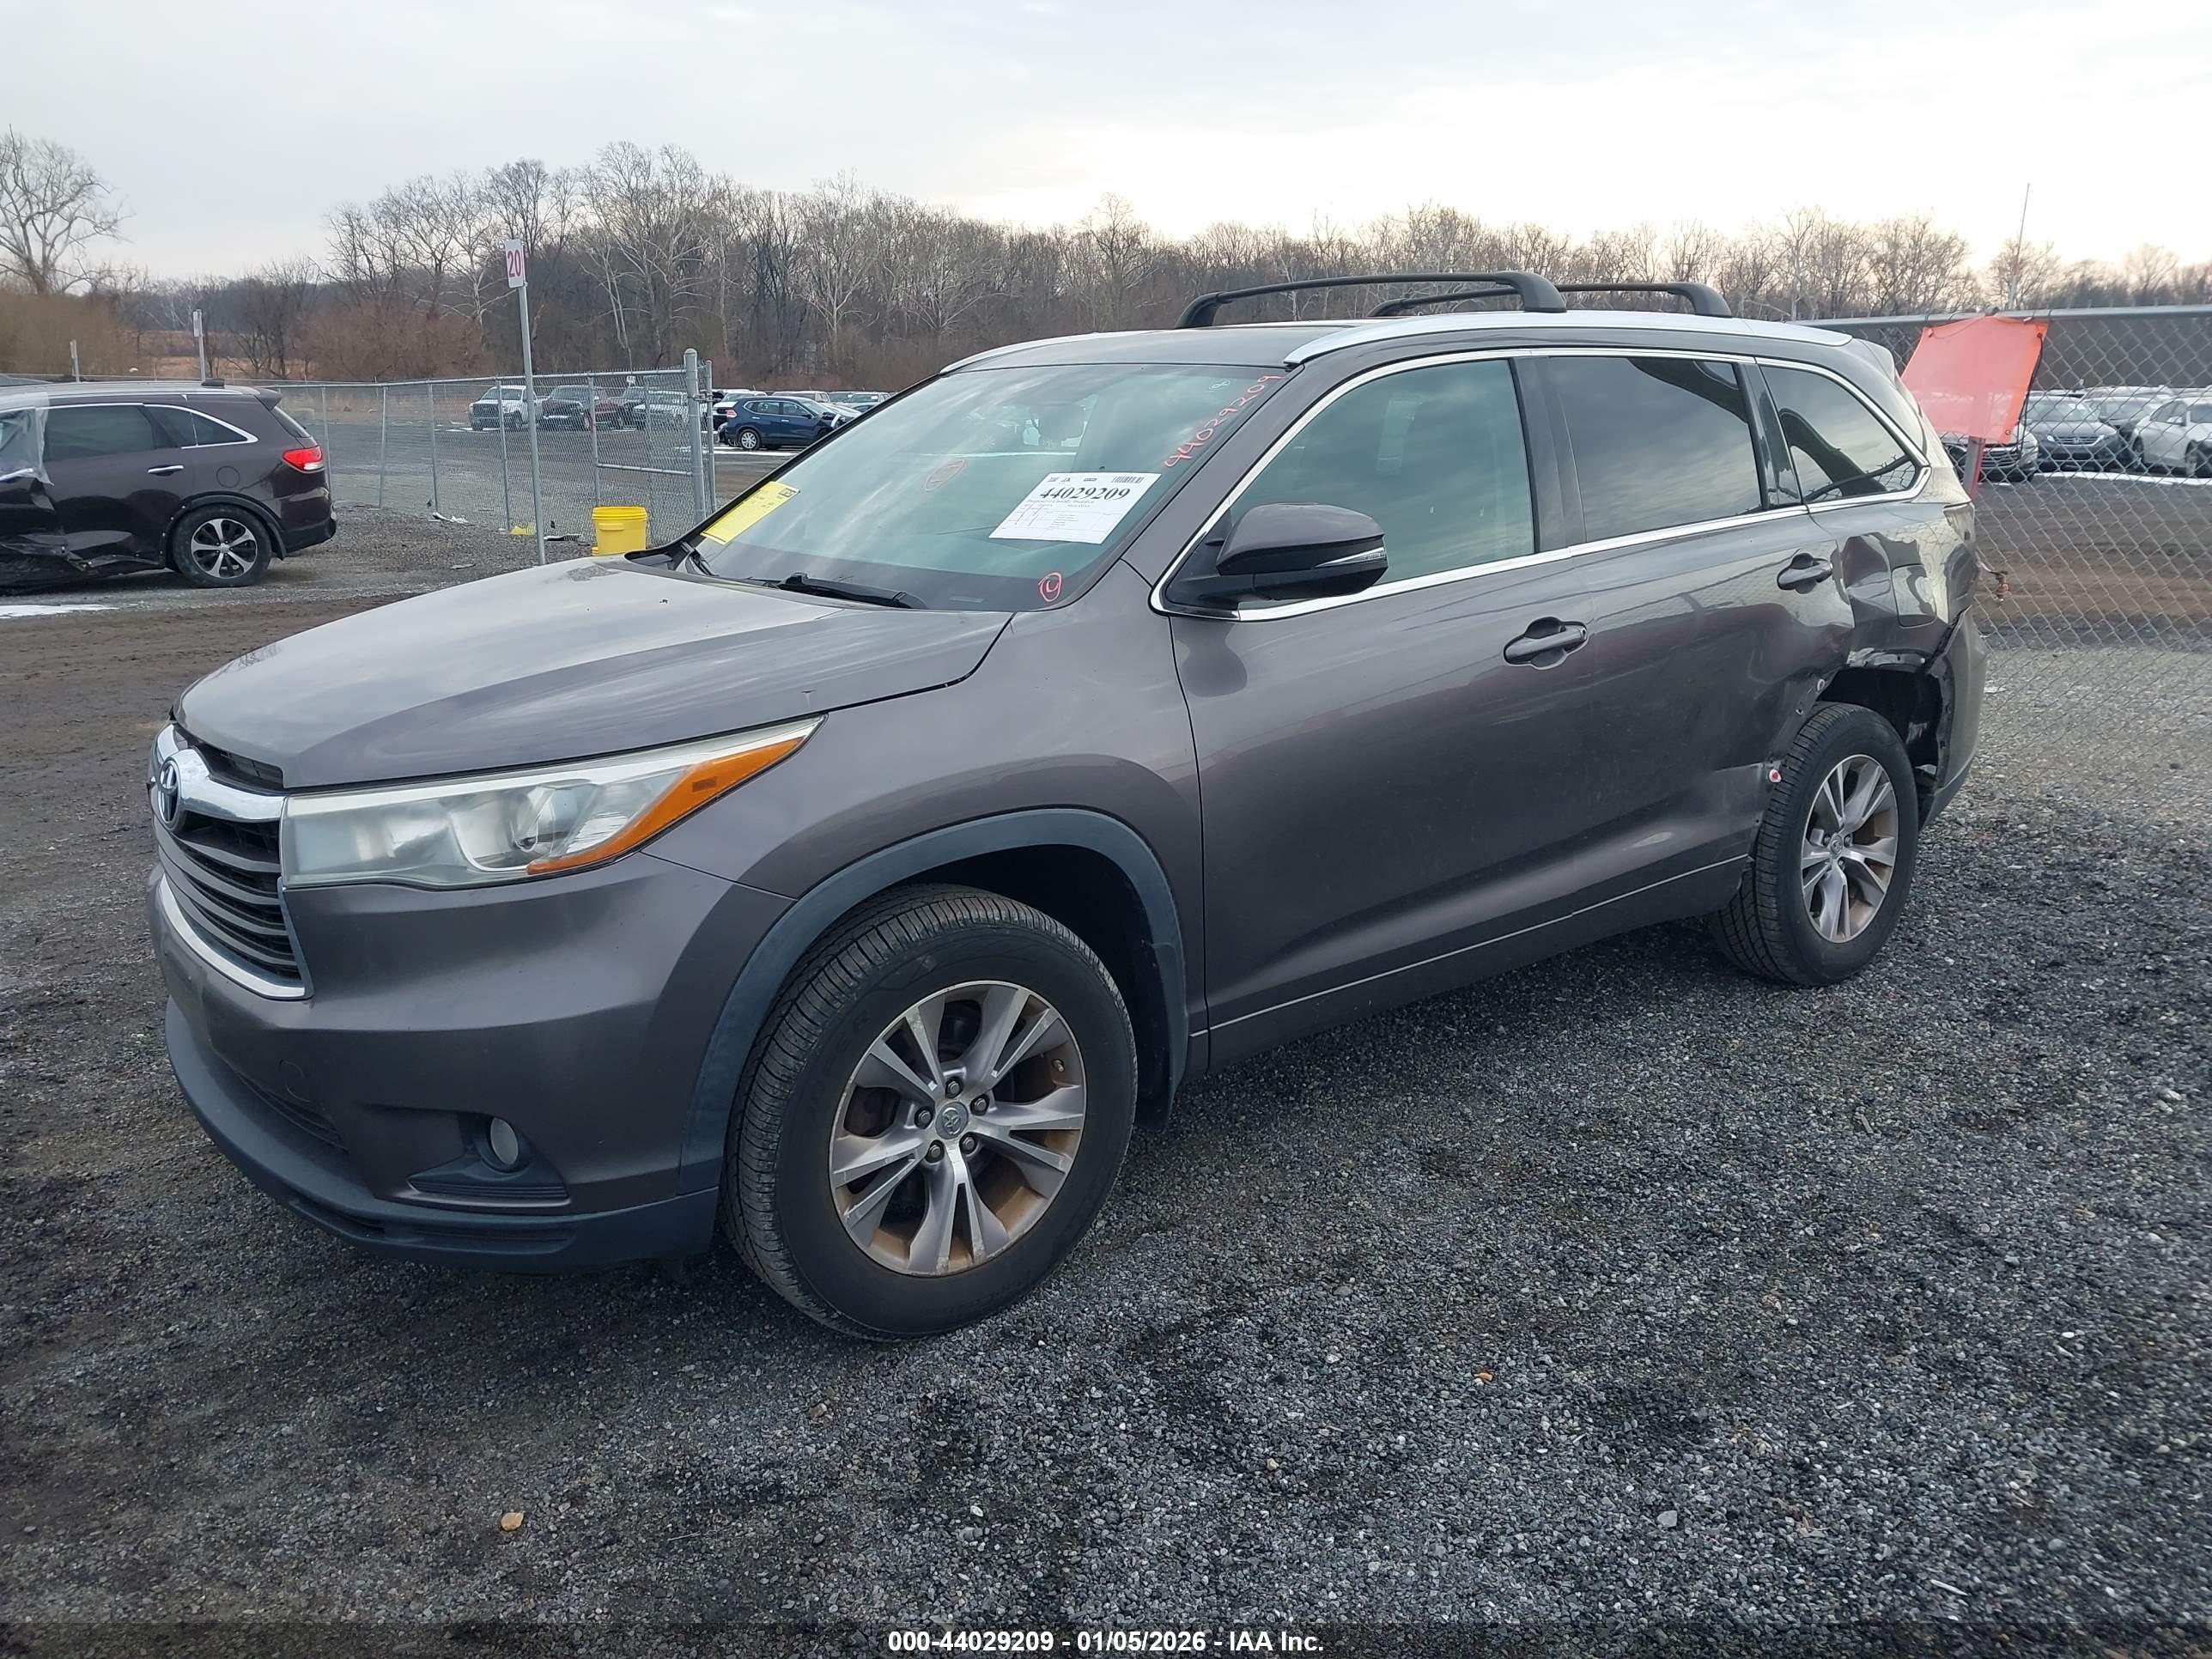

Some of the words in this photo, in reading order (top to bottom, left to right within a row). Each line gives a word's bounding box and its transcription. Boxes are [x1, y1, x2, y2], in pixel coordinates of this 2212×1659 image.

[507, 249, 521, 277] 20
[1164, 375, 1285, 466] 44029209
[1040, 487, 1131, 501] 44029209
